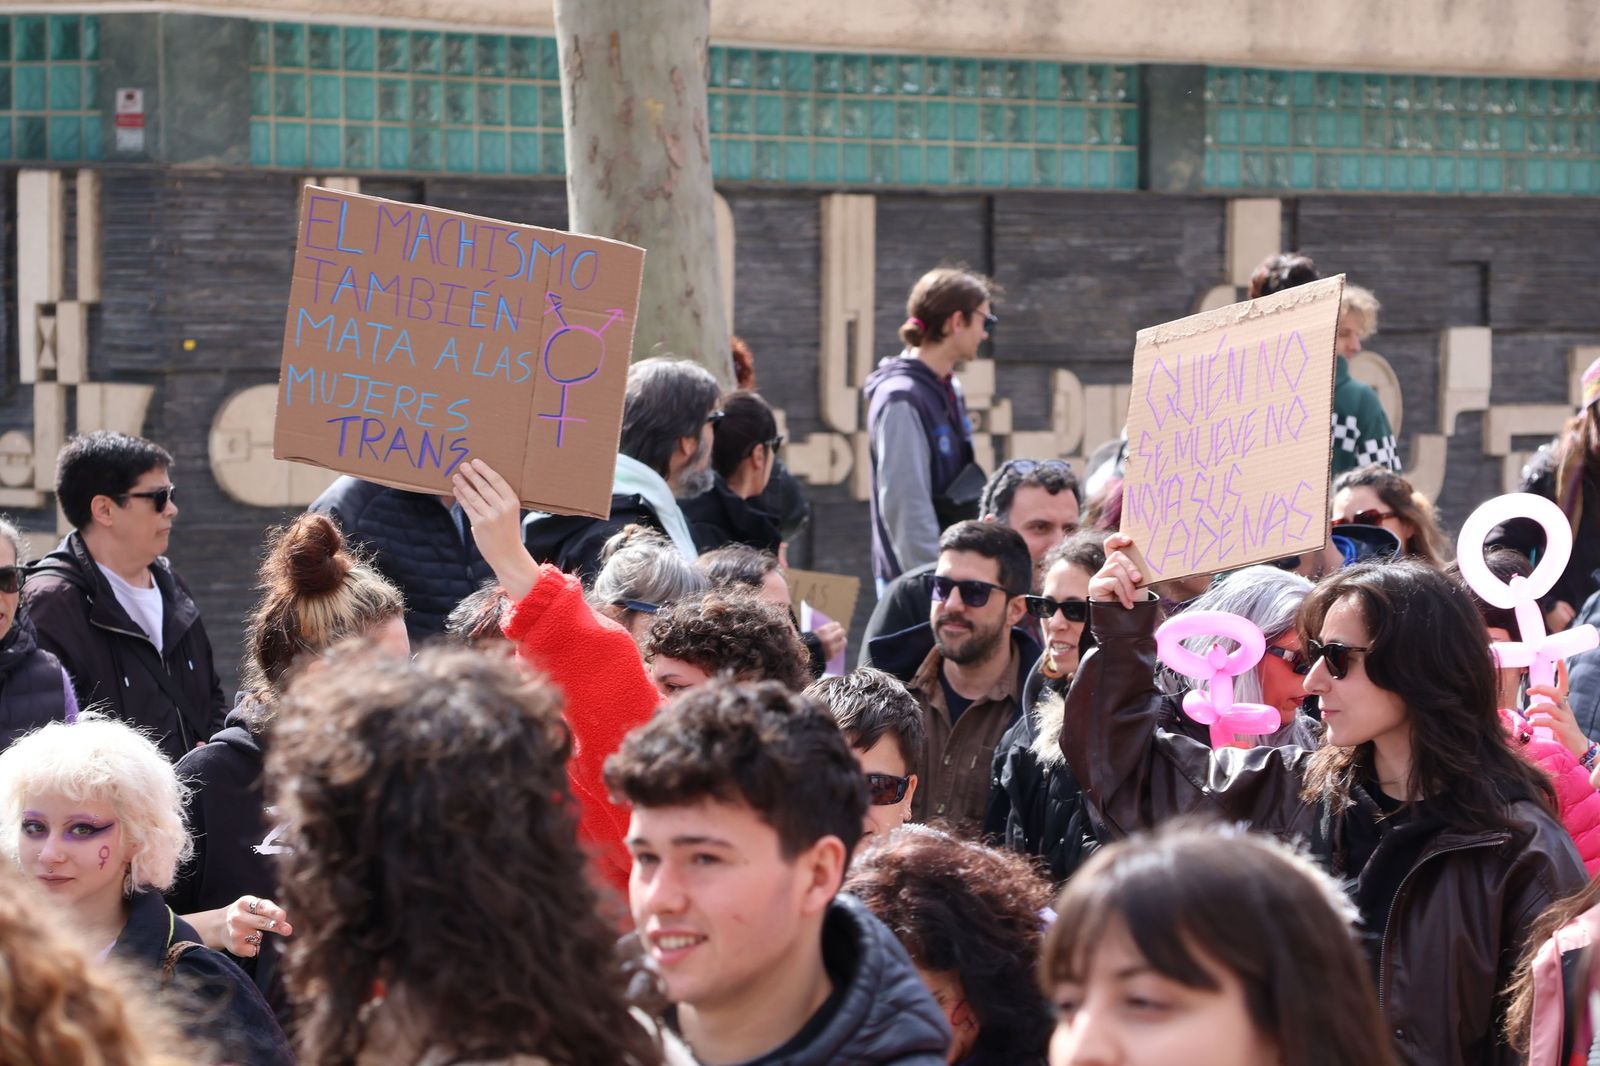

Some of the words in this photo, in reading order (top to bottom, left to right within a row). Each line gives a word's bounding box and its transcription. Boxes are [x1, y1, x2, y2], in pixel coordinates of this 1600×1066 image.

[305, 196, 363, 254] EL
[374, 204, 598, 291] MACHISMO
[304, 256, 522, 332] TAMBIÉN
[296, 308, 416, 367] MATA
[433, 337, 460, 373] A
[472, 342, 532, 384] LAS
[1146, 334, 1246, 431] QUIÉN
[1256, 330, 1309, 400] NO
[287, 363, 470, 431] MUJERES
[327, 416, 469, 477] TRANS
[1139, 430, 1169, 484] SE
[1175, 408, 1256, 470] MUEVE
[1265, 395, 1309, 447] NO
[1128, 472, 1183, 529] NOTA
[1191, 463, 1241, 522] SUS
[1145, 480, 1313, 575] CADENAS
